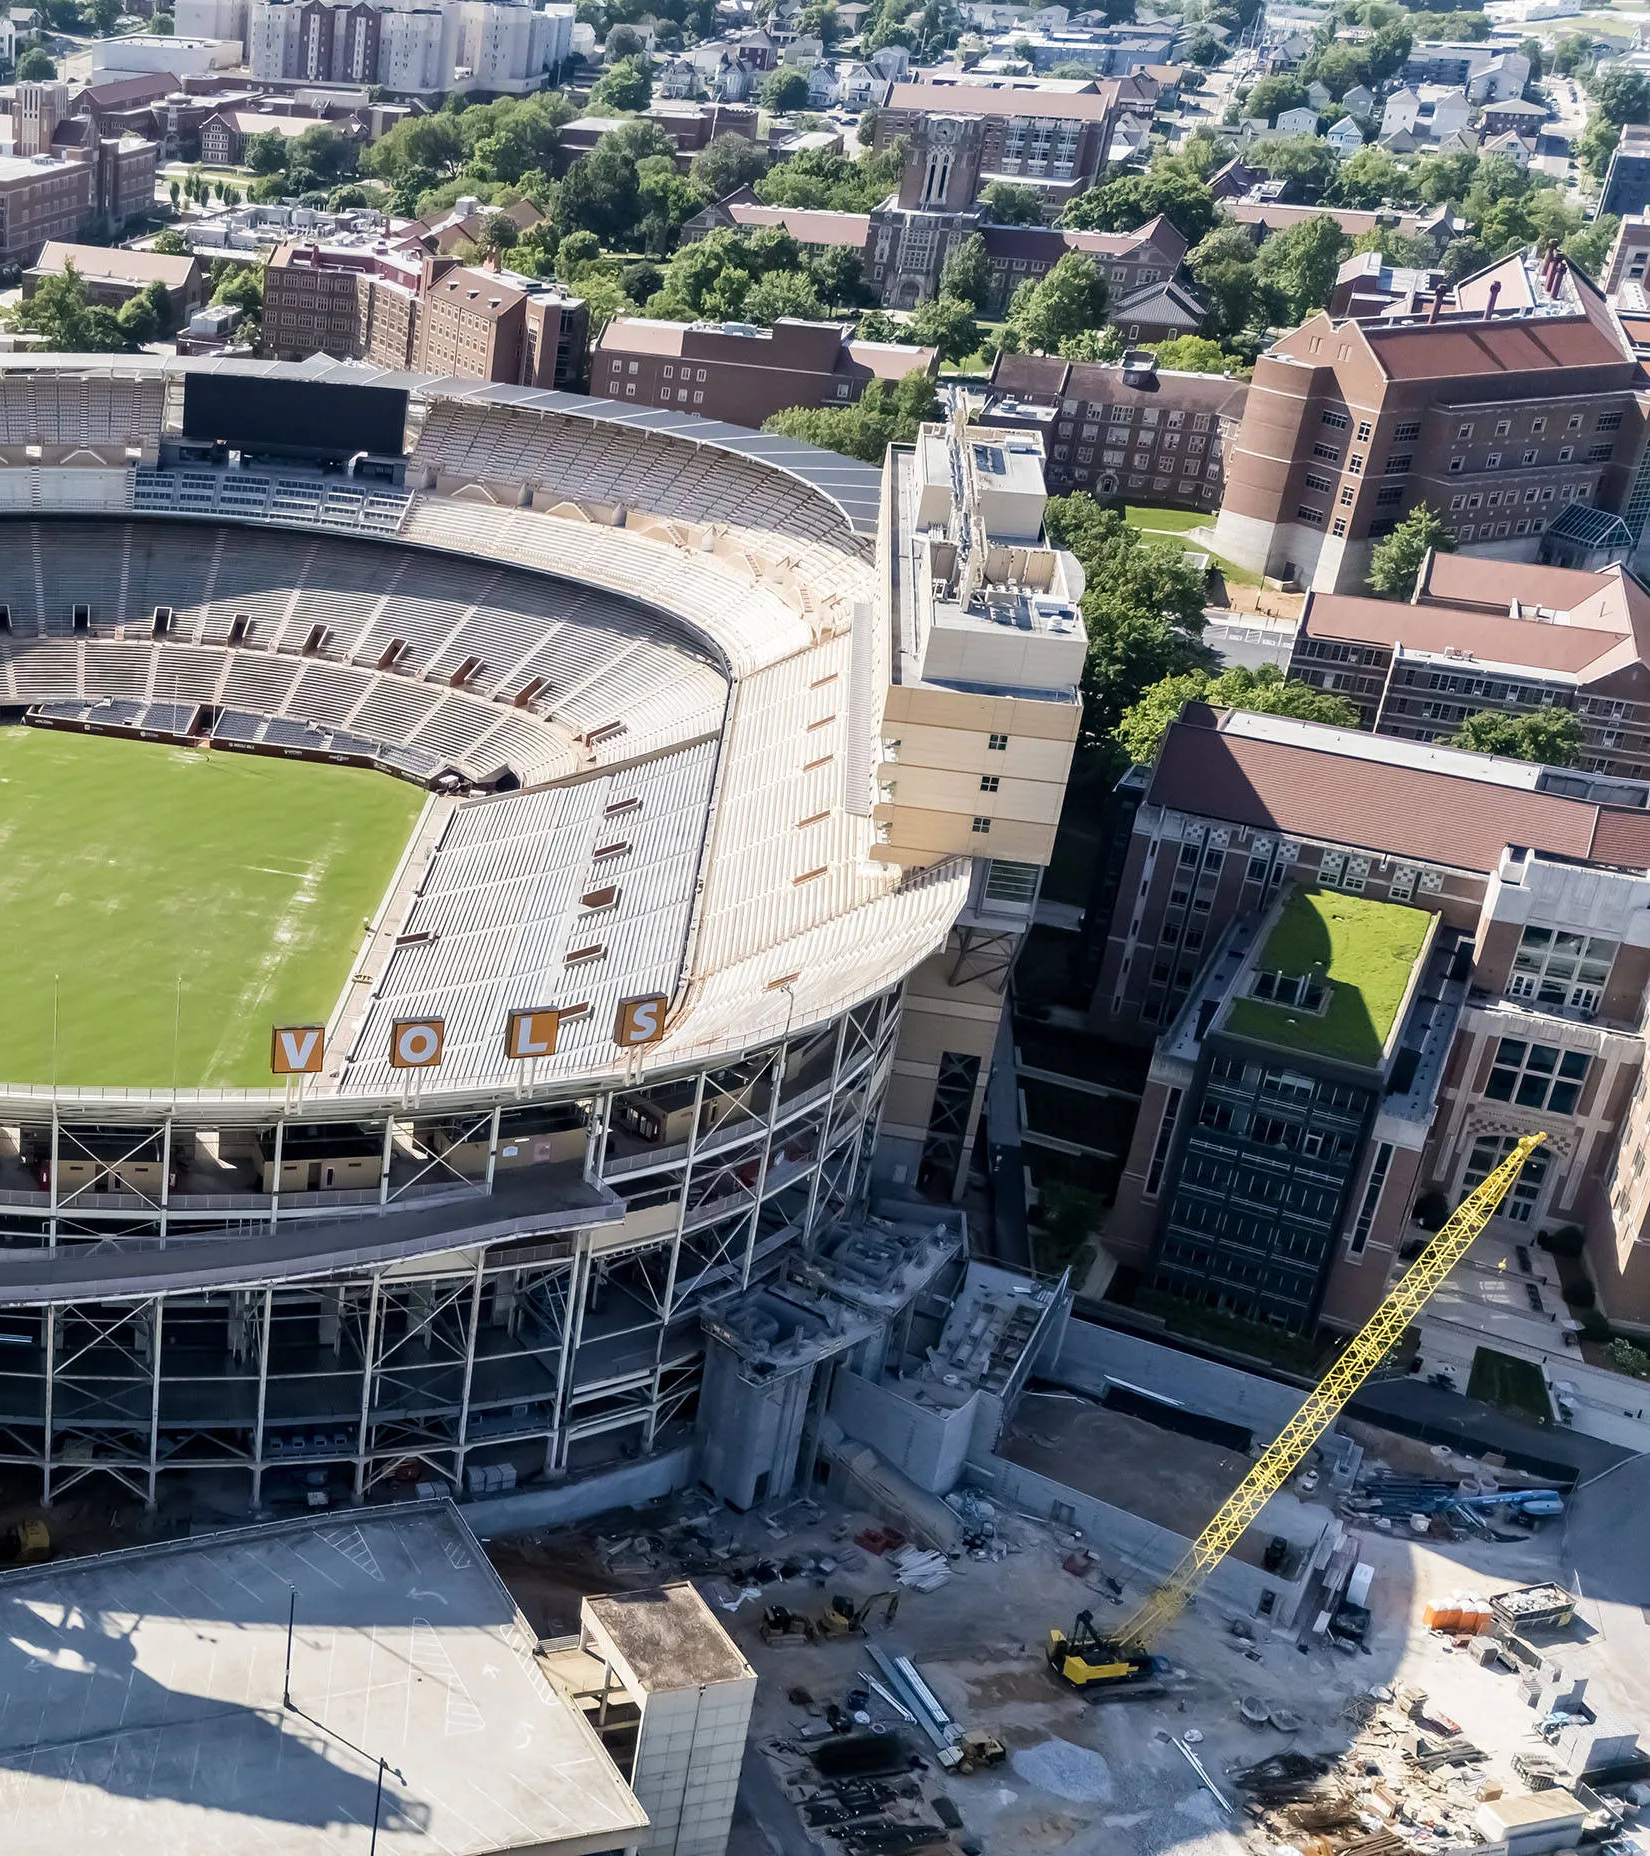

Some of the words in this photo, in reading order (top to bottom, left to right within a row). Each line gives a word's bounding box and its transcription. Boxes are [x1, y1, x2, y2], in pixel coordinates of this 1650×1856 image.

[517, 1017, 548, 1055] L
[629, 1002, 659, 1042] S
[281, 1032, 318, 1069] V
[399, 1025, 439, 1064] O
